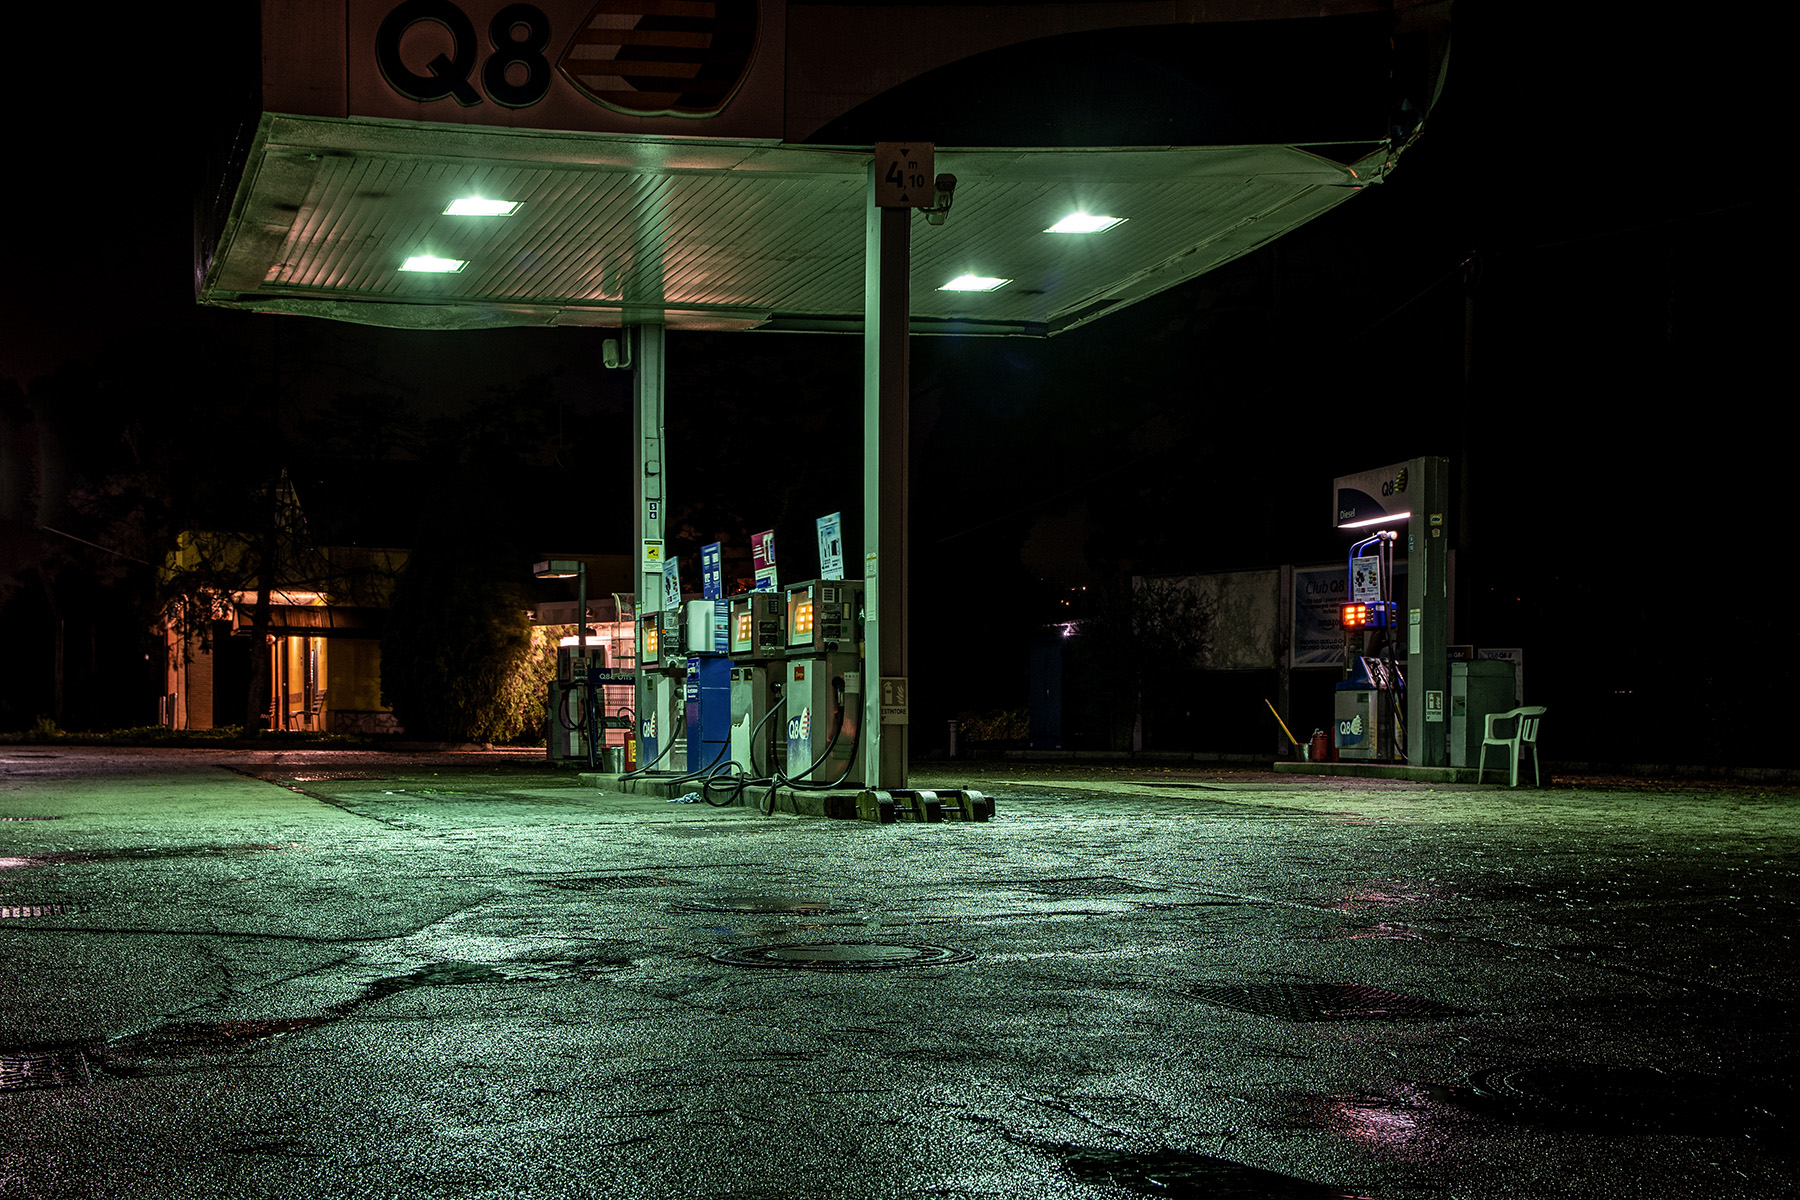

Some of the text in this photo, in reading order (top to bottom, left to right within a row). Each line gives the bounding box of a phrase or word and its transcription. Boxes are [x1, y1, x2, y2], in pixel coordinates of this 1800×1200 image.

[375, 0, 552, 109] Q8
[1382, 480, 1394, 497] Q8
[1339, 508, 1356, 520] Diesel
[1305, 579, 1345, 595] Club Q8
[643, 721, 650, 737] Q8
[788, 719, 799, 740] Q8
[1340, 721, 1351, 735] Q8
